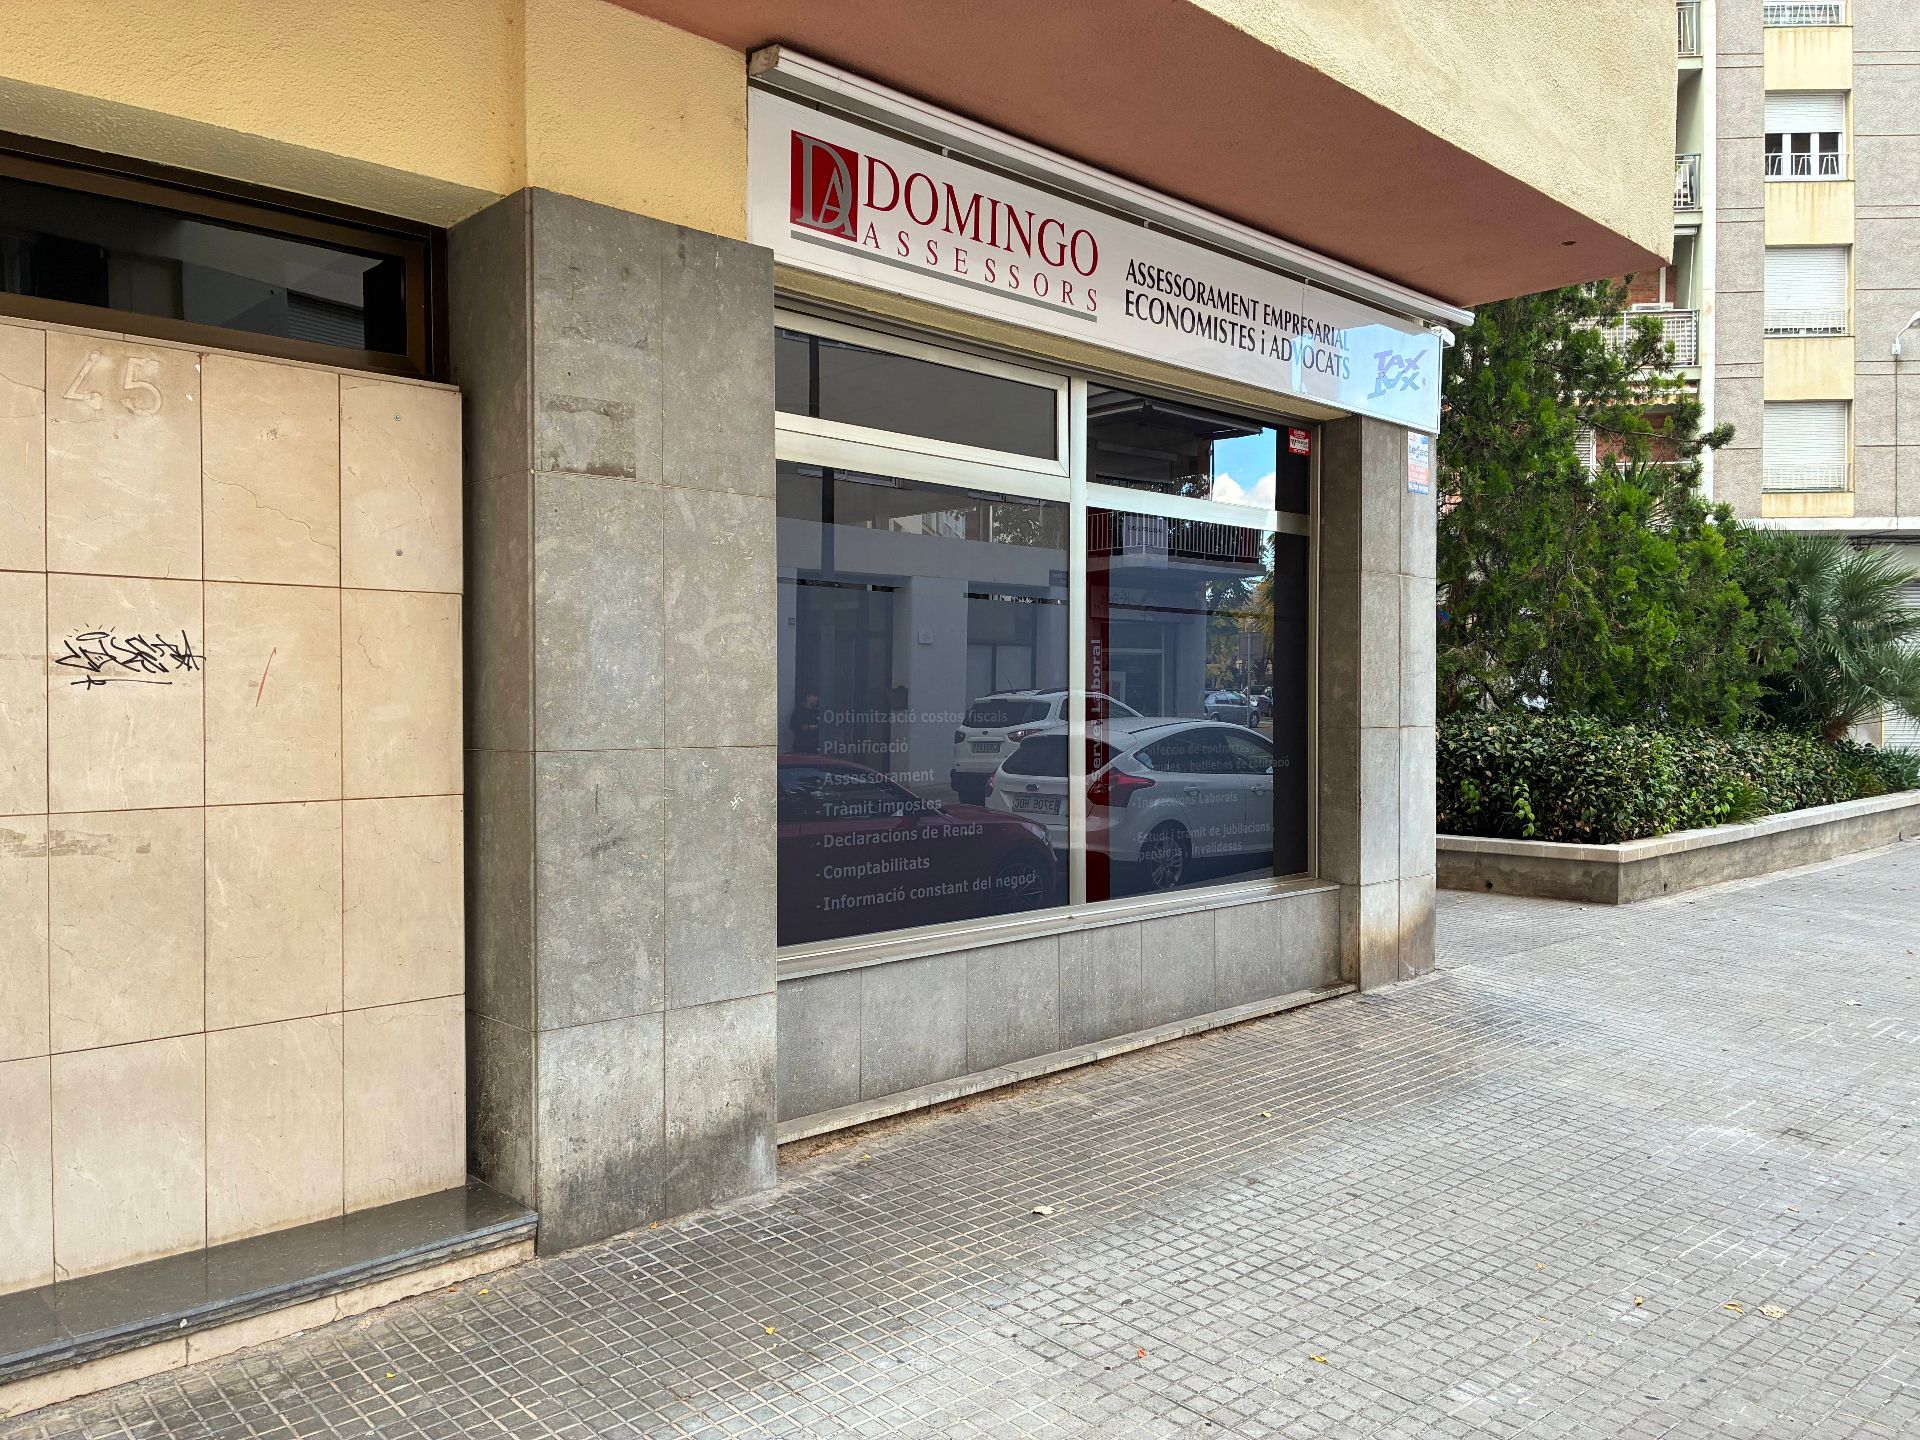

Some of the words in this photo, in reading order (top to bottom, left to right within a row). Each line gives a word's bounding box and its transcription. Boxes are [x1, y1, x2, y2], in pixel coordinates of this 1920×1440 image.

[862, 154, 1099, 277] DOMINGO
[861, 221, 1098, 312] ASSESSORS
[1125, 258, 1260, 322] ASSESSORAMENT
[1263, 304, 1350, 351] EMPRESARIAL
[1125, 288, 1256, 352] ECONOMISTES
[1260, 330, 1266, 355] i
[1269, 334, 1351, 380] ADVOCATS
[921, 709, 965, 724] costos
[823, 737, 909, 755] Planificació
[1188, 743, 1200, 755] de
[1199, 791, 1239, 805] Laborals
[823, 828, 919, 848] Declaracions
[922, 825, 939, 839] de
[943, 820, 984, 838] Renda
[1210, 825, 1221, 837] de
[823, 856, 931, 880] Comptabilitats
[910, 878, 969, 899] constant
[972, 875, 992, 892] del
[996, 868, 1037, 889] negoci
